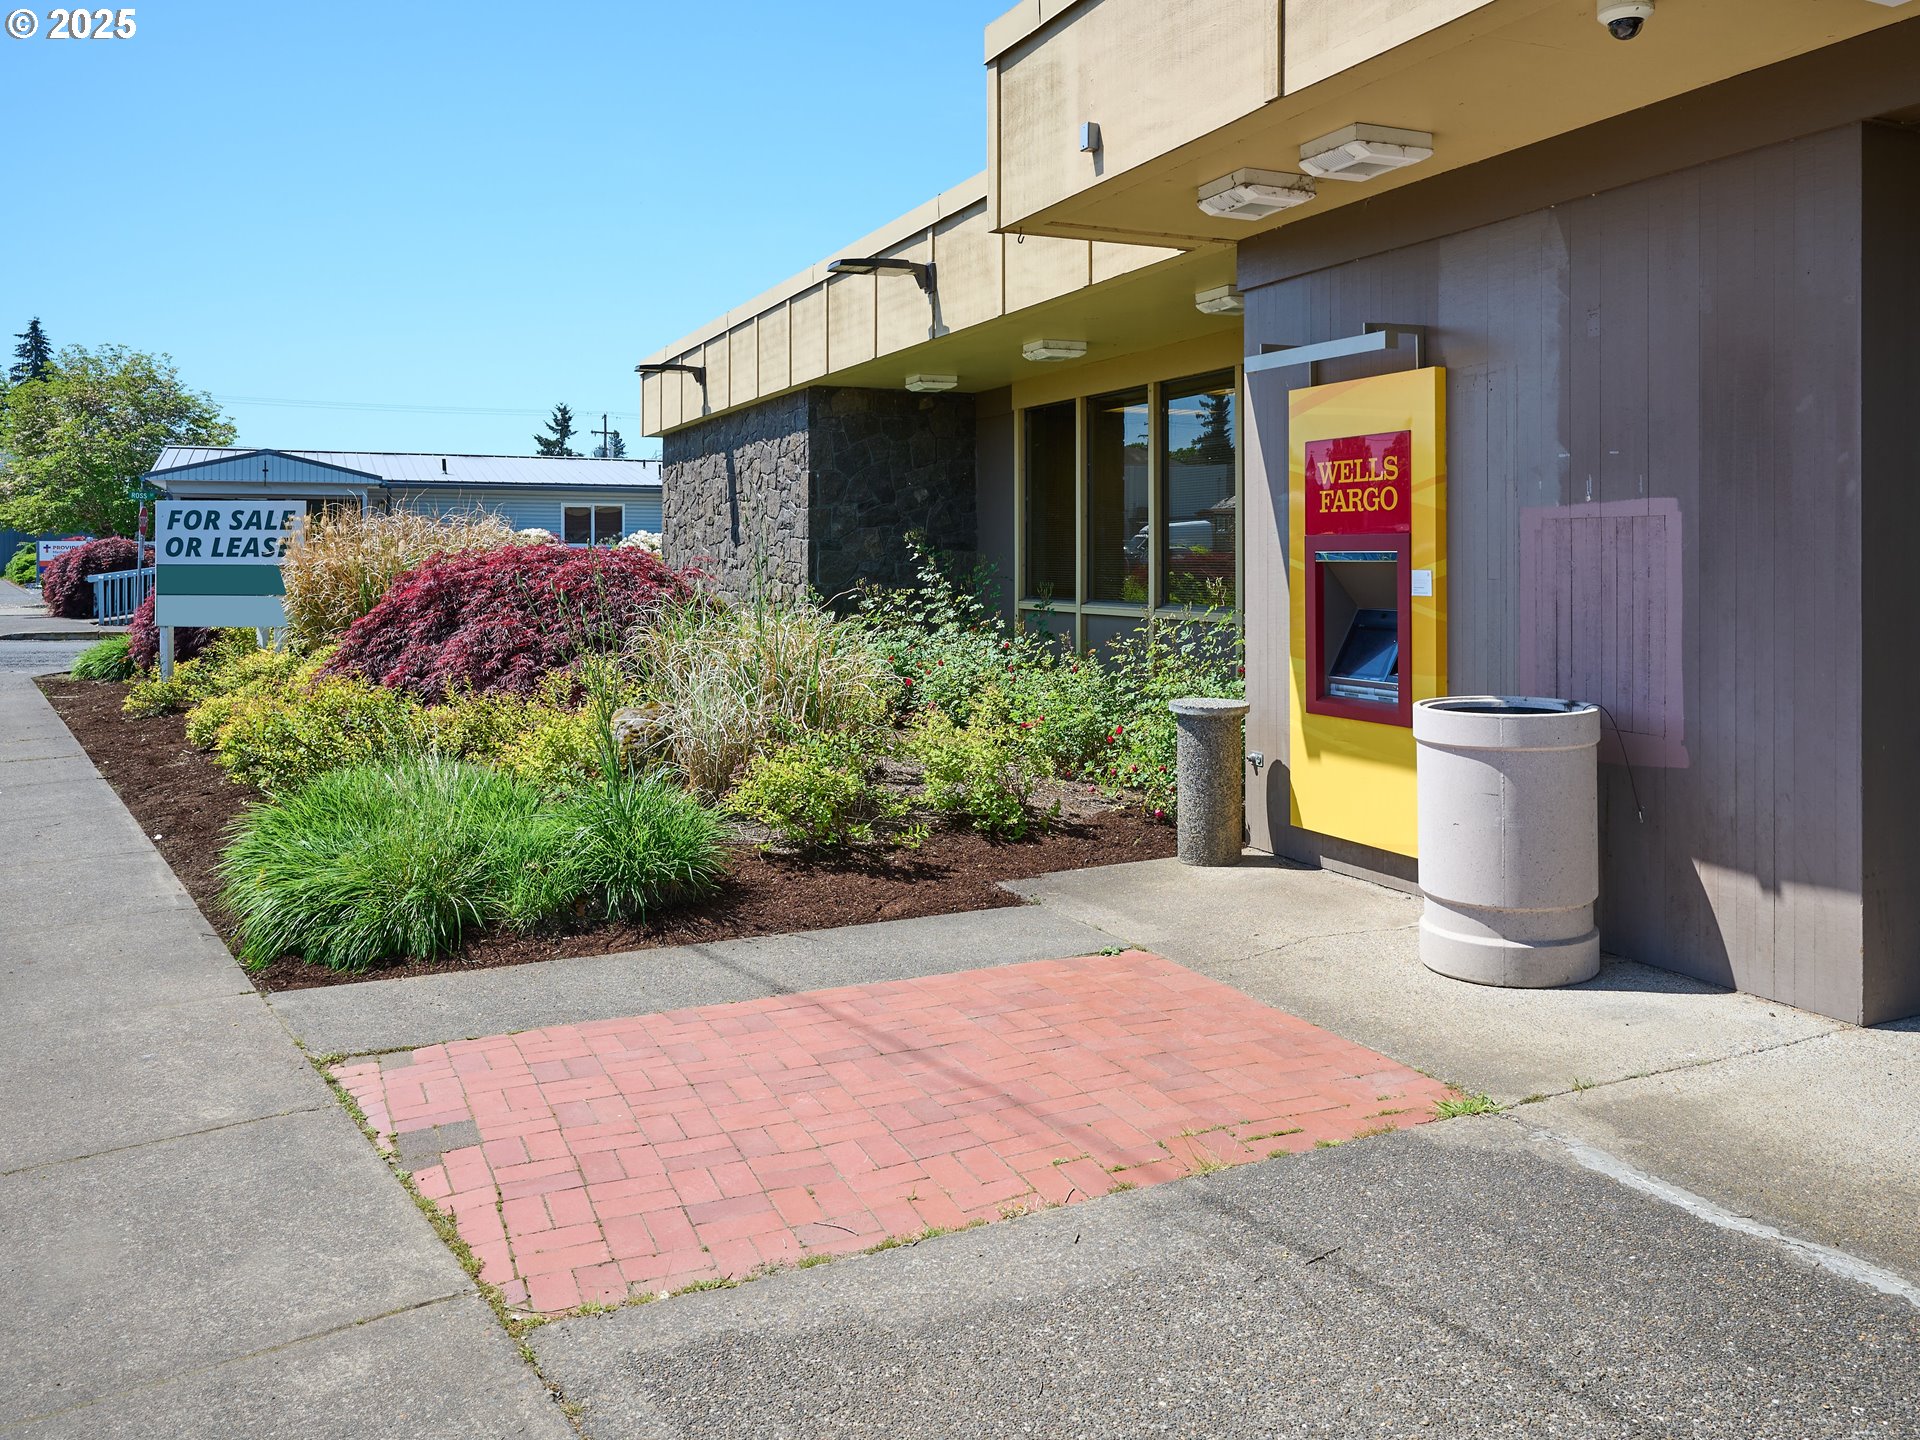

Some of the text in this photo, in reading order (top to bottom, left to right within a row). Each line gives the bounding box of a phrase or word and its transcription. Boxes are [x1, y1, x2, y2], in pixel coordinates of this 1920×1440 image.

[1317, 455, 1399, 484] WELLS
[1319, 486, 1399, 513] FARGO
[167, 510, 221, 530] FOR
[229, 510, 296, 530] SALE
[165, 537, 202, 557] OR
